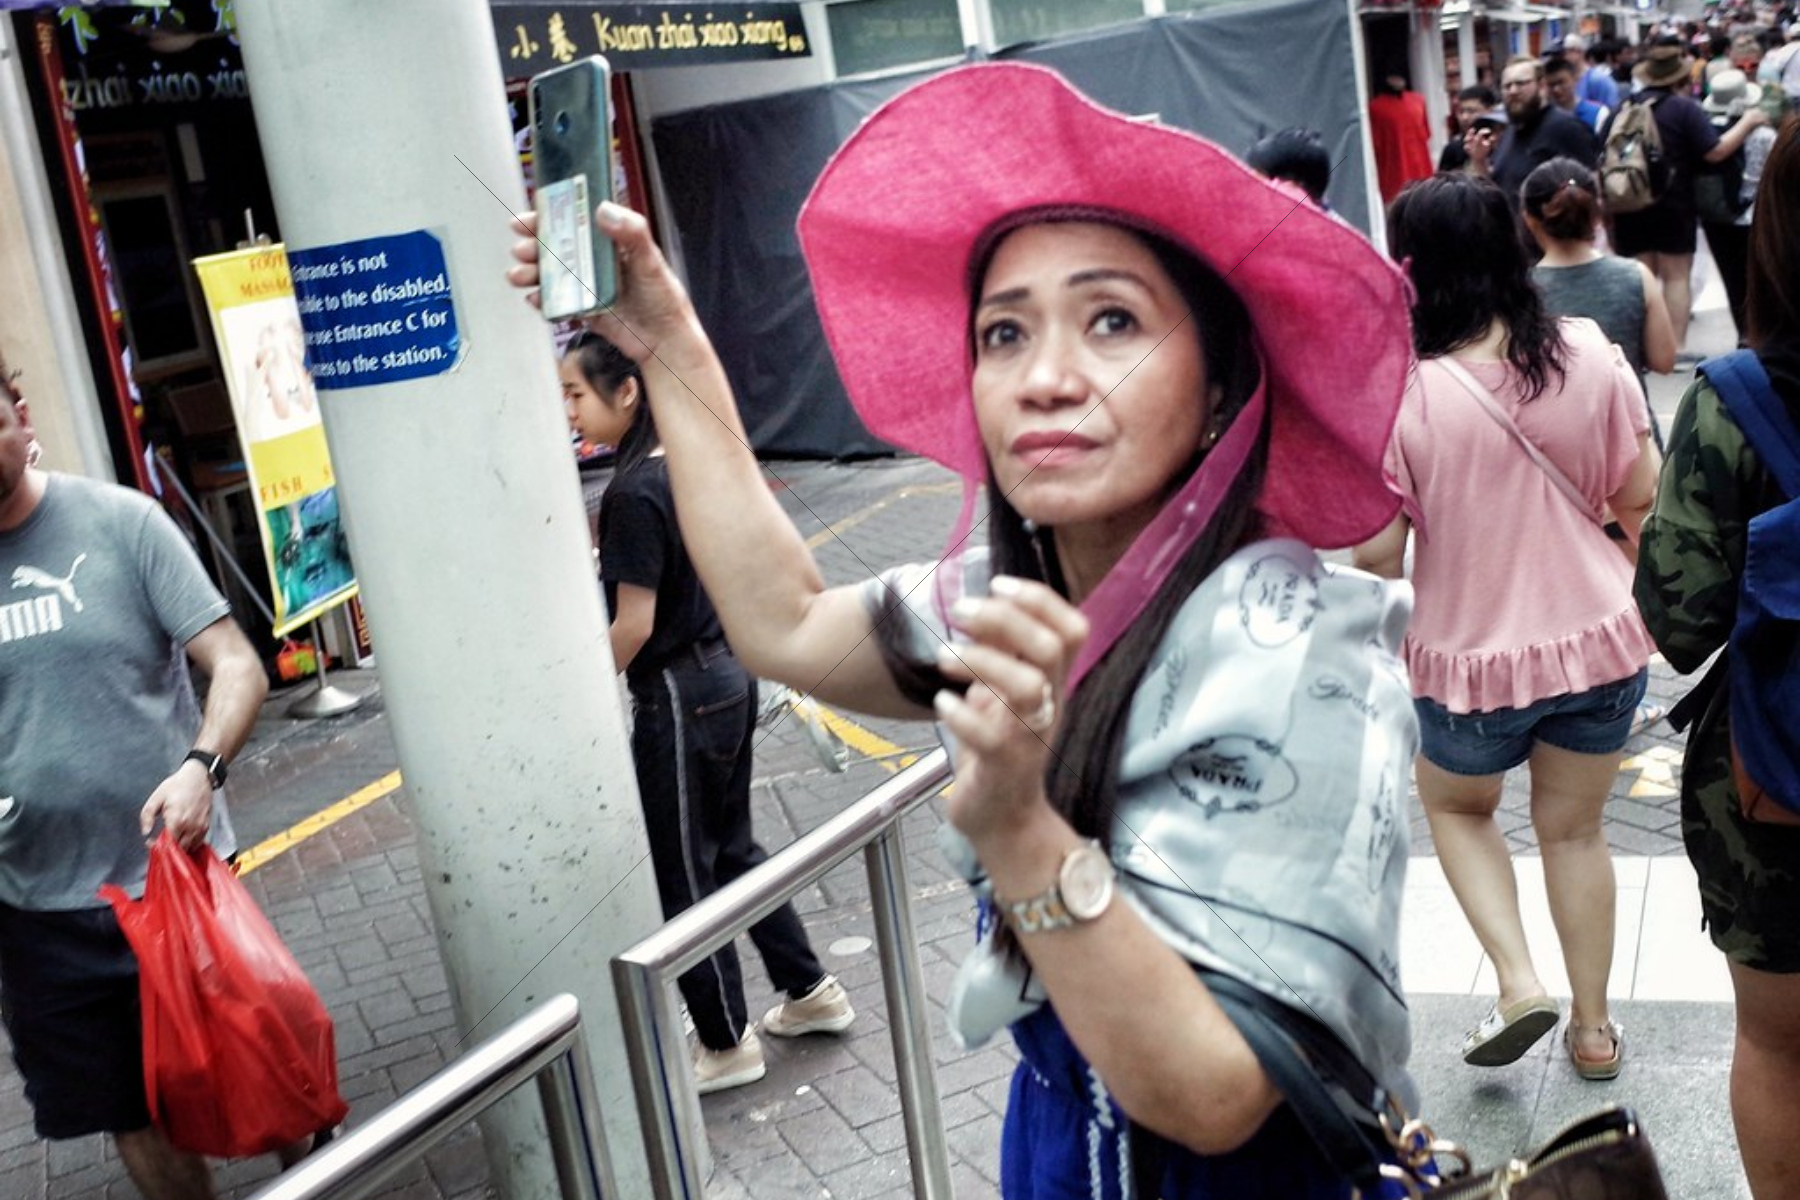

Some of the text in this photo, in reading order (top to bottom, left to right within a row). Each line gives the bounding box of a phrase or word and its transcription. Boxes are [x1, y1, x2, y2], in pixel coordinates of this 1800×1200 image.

[591, 12, 654, 51] Kuan
[656, 12, 698, 49] zhai
[699, 12, 738, 46] xiao
[740, 11, 788, 51] xiang
[138, 60, 201, 104] xiao
[207, 57, 249, 100] xia
[340, 255, 354, 275] is
[358, 251, 389, 273] not
[324, 296, 340, 312] to
[341, 288, 368, 309] the
[370, 272, 451, 304] disabled.
[334, 318, 402, 343] Entrance
[405, 312, 419, 332] C
[420, 308, 448, 329] for
[336, 358, 351, 376] to
[352, 353, 379, 375] the
[381, 345, 448, 370] station.
[260, 475, 303, 502] FISH
[0, 593, 64, 644] MA
[1189, 762, 1264, 794] PRADA
